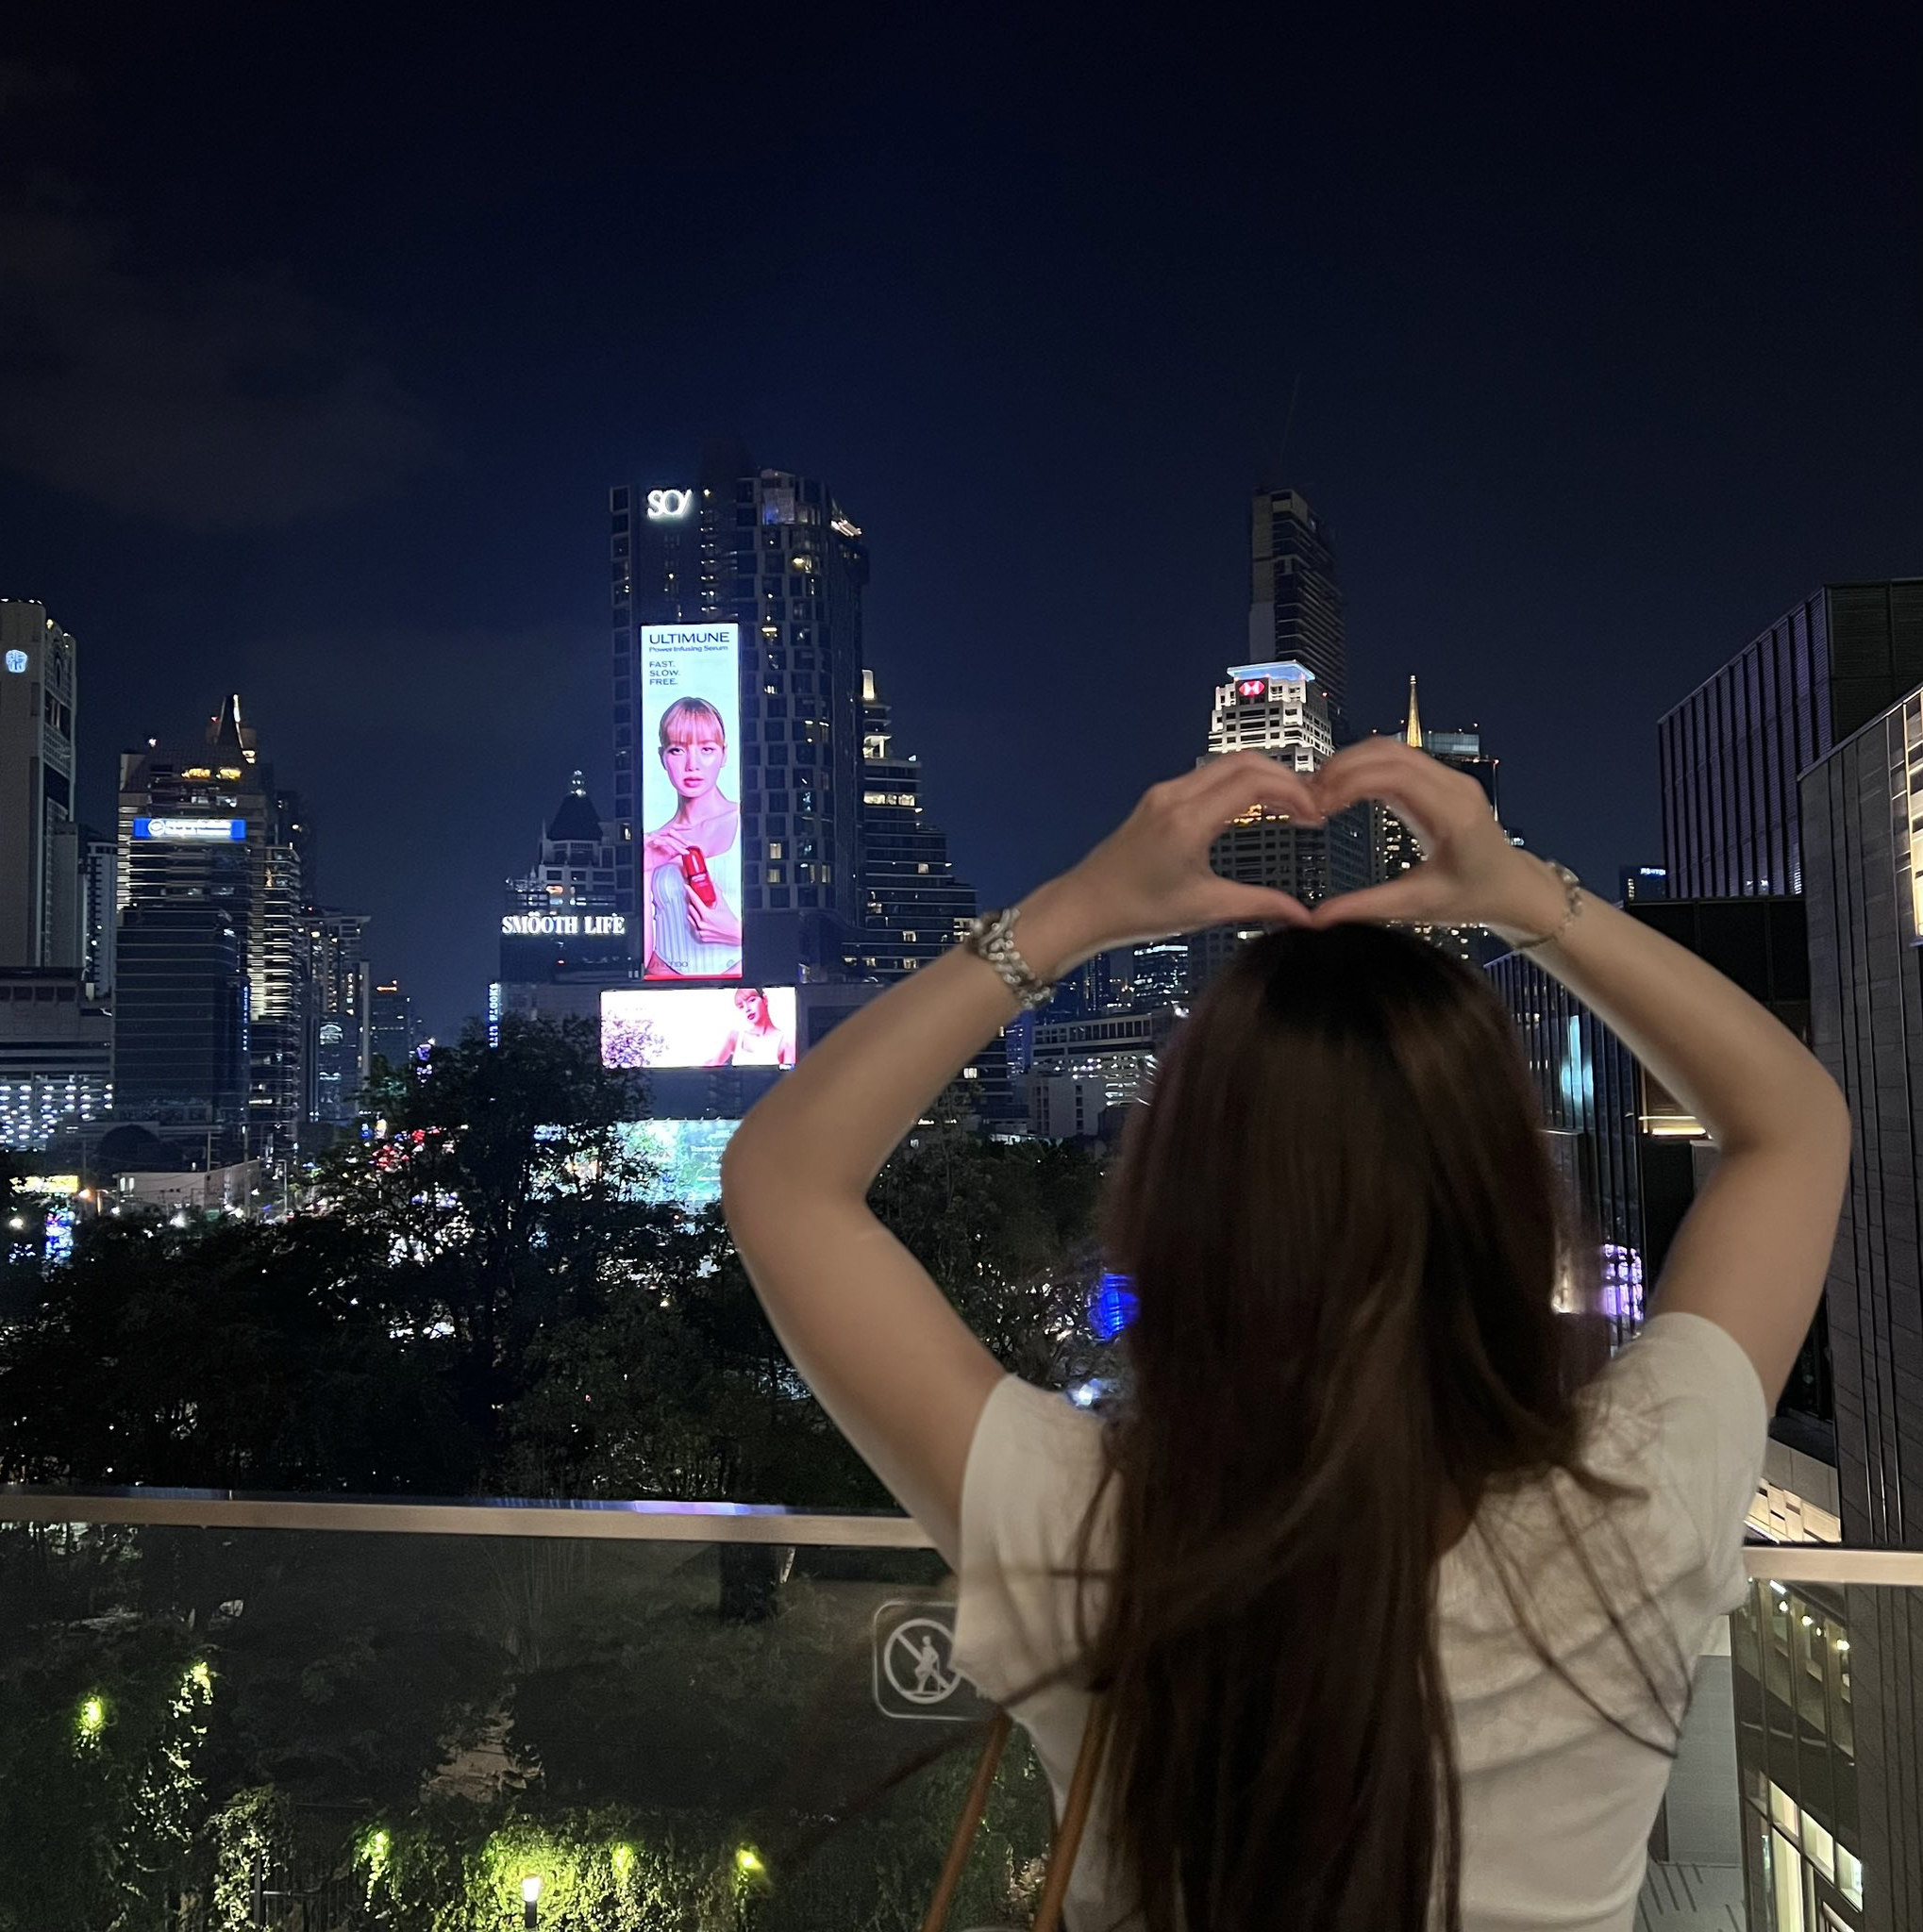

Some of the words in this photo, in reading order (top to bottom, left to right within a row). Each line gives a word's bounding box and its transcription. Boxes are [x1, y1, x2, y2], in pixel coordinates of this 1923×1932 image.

[649, 632, 730, 644] ULTIMUNE
[501, 915, 578, 934] SMOOTH
[584, 915, 626, 934] LIFE
